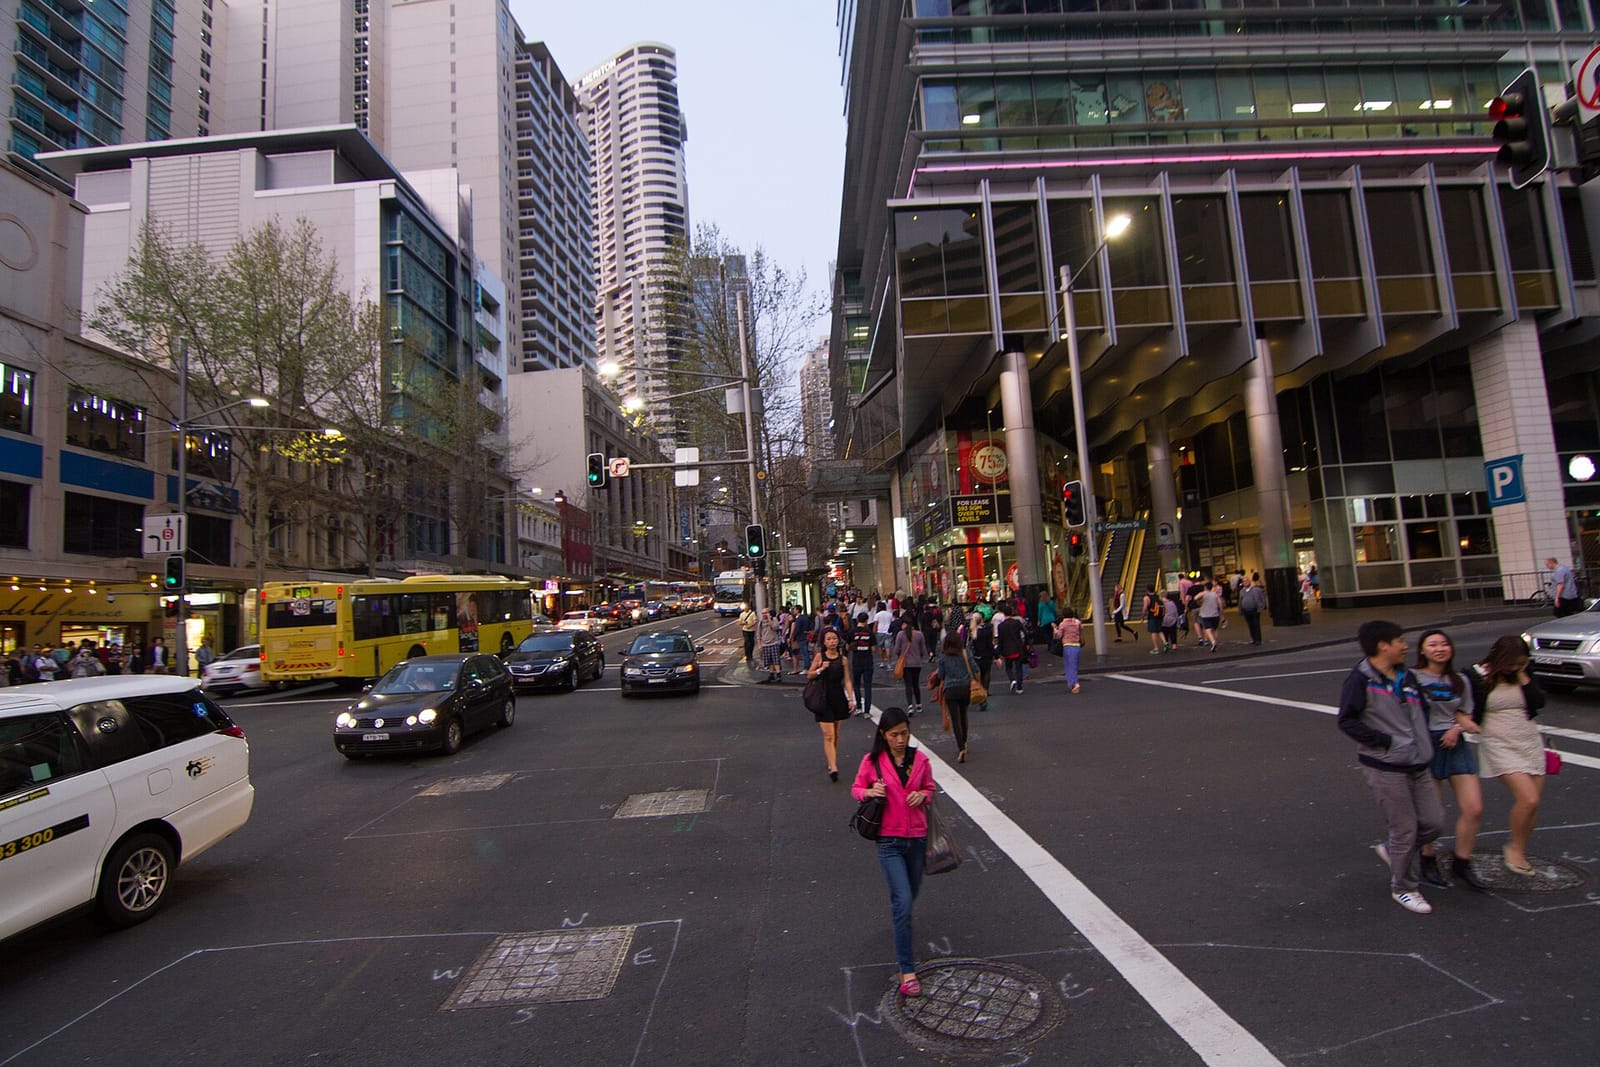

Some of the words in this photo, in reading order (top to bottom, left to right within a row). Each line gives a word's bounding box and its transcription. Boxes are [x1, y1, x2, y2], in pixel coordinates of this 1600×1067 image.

[582, 58, 617, 85] MERITON
[1492, 466, 1514, 498] P
[21, 828, 54, 851] 300
